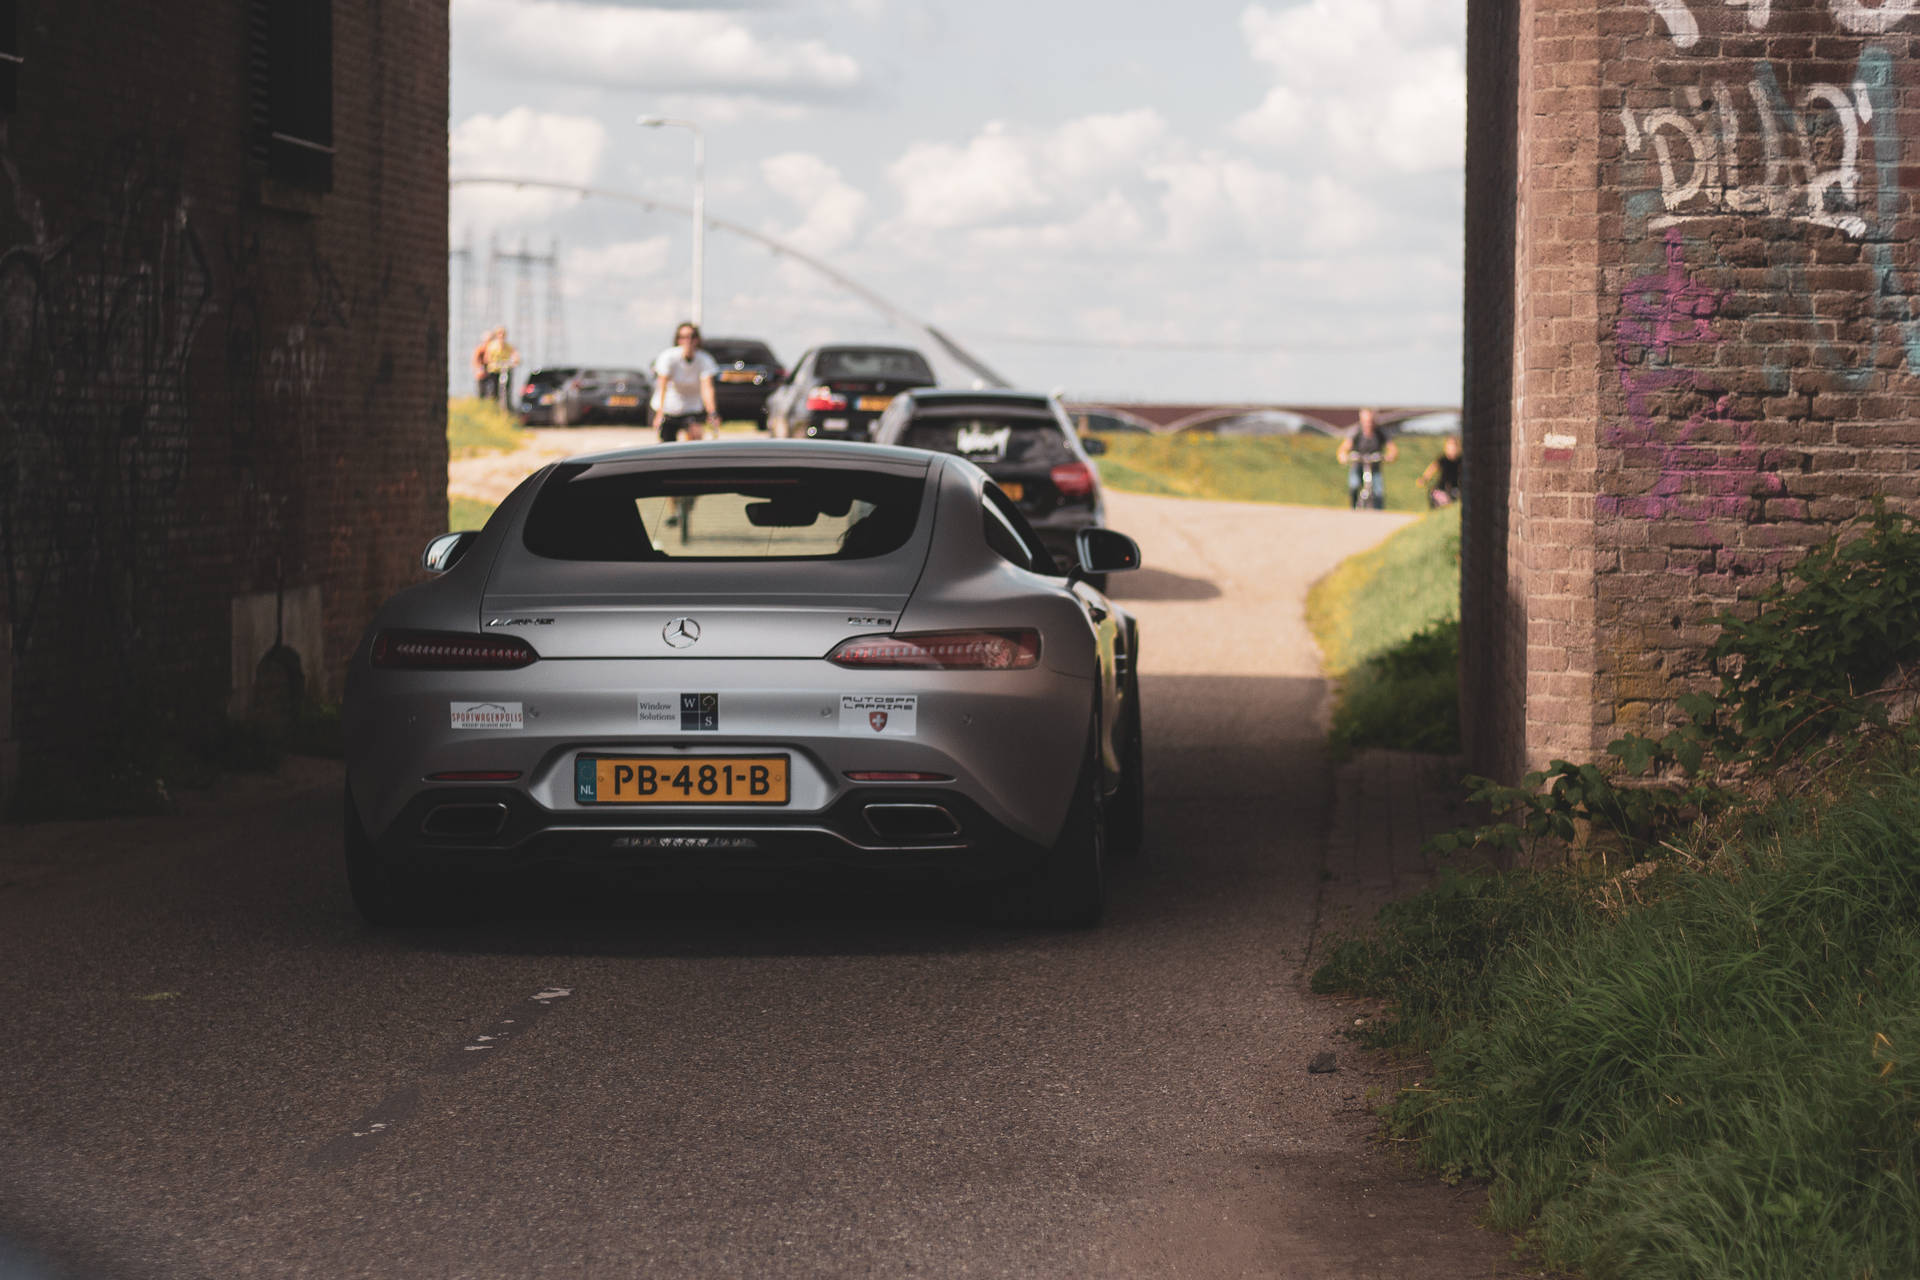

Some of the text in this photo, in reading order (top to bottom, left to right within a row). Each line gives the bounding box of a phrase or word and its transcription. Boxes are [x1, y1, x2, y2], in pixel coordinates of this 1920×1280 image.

[683, 697, 696, 708] W
[842, 695, 916, 704] AUTOSPA
[639, 702, 672, 710] Window
[451, 712, 523, 723] SPORTWAGENPOLIS
[639, 711, 676, 721] Solutions
[704, 715, 713, 727] S
[613, 764, 770, 796] PB-481-B
[580, 785, 594, 796] NL
